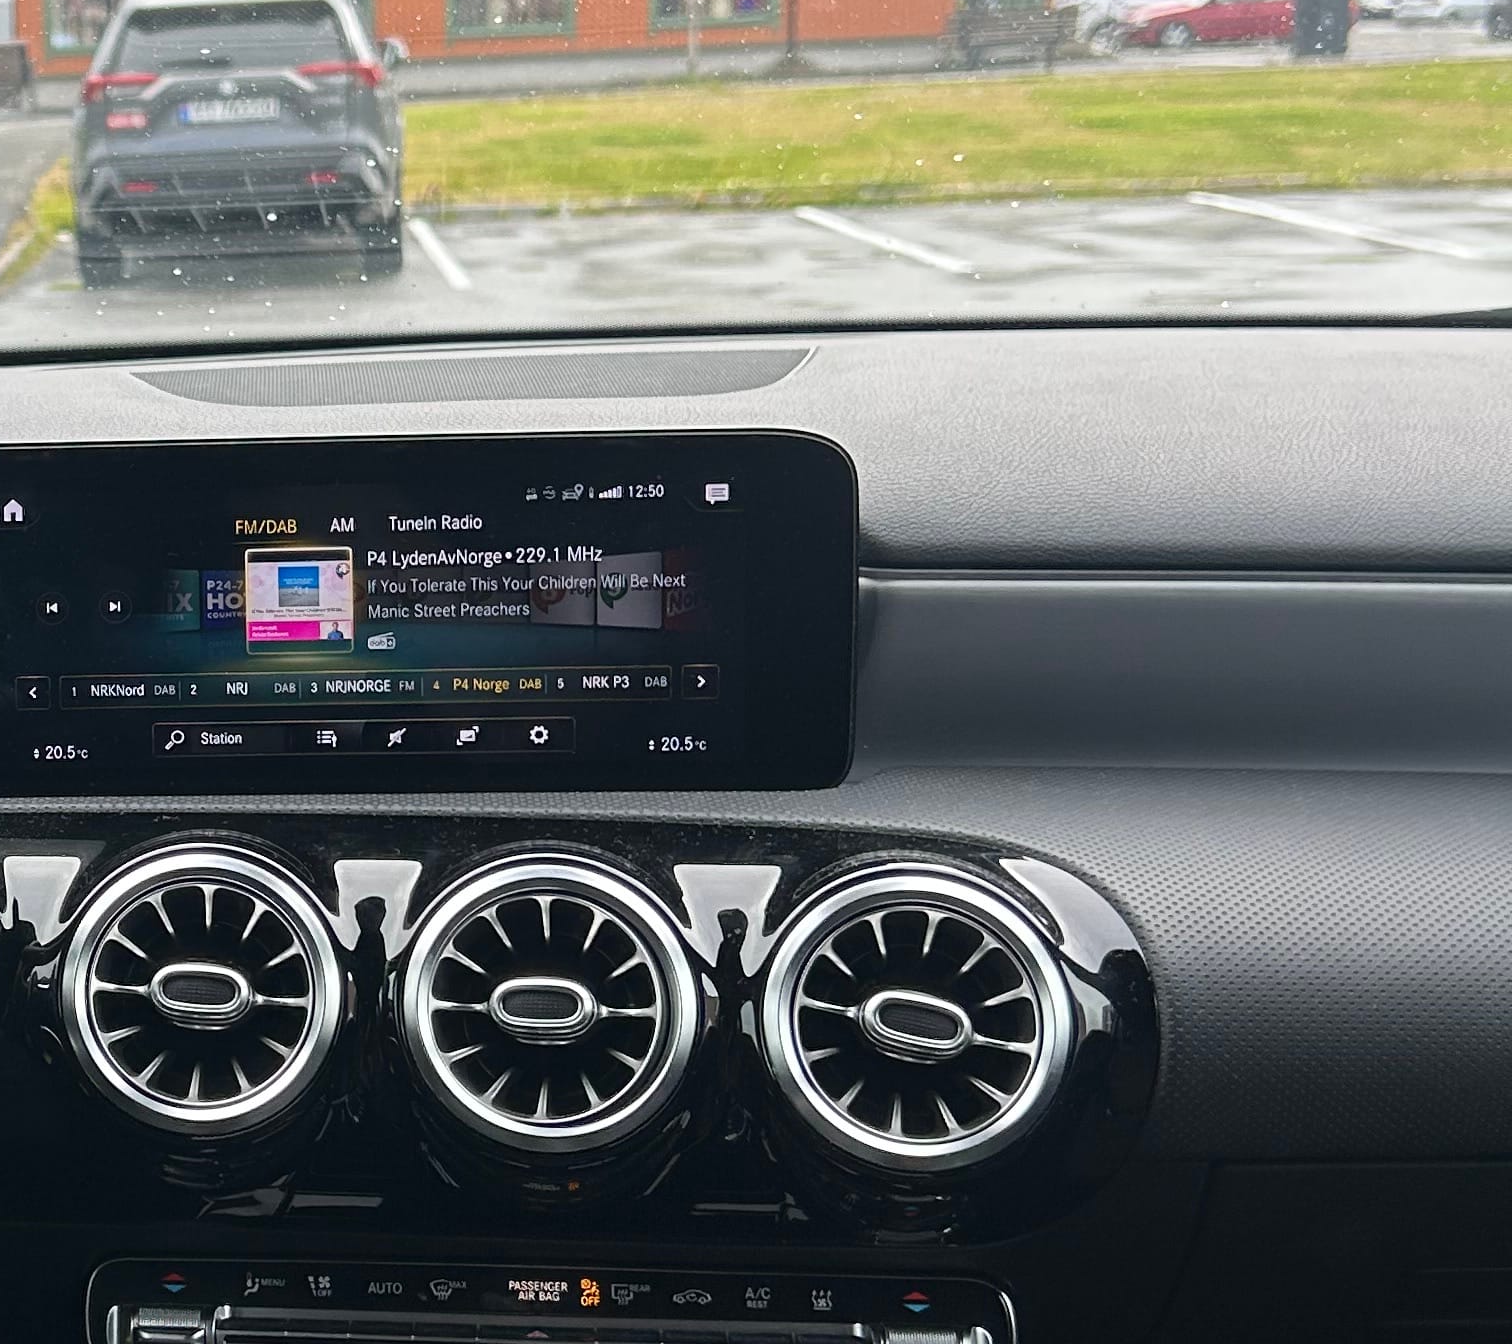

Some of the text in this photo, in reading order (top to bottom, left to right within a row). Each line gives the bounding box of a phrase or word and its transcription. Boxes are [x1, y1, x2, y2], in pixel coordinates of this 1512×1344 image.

[628, 483, 665, 498] 12:50
[235, 519, 298, 535] FM/DAB
[329, 517, 355, 532] AM
[388, 514, 483, 532] TuneIn Radio
[367, 546, 603, 569] P4 LydenAvNorge 229.1 MHz
[206, 580, 244, 591] P24-7
[367, 578, 378, 594] If
[380, 578, 407, 594] You
[410, 577, 467, 593] Tolerate
[470, 576, 498, 592] This
[501, 577, 534, 591] Your
[538, 575, 596, 590] Children
[600, 574, 626, 588] Will
[630, 574, 648, 588] Be
[652, 573, 686, 588] Next
[207, 592, 246, 610] HO
[367, 602, 530, 619] Manic Street Preachers
[190, 681, 297, 696] 2 NRJ DAB
[310, 679, 415, 693] 3 NRJNORGE FM
[433, 678, 542, 693] 4 P4 Norge DAB
[557, 675, 668, 690] 5 NRK P3 DAB
[71, 684, 176, 697] 1 NRKNord DAB
[200, 731, 243, 745] Station
[661, 737, 707, 752] 20.5°C
[45, 745, 89, 760] 20.5°C
[260, 1279, 286, 1287] MENU
[367, 1281, 403, 1295] AUTO
[448, 1281, 467, 1289] MAX
[508, 1280, 568, 1293] PASSENGER
[629, 1284, 651, 1293] REAR
[317, 1288, 332, 1297] OFF
[517, 1291, 561, 1302] AIR BAG
[744, 1287, 771, 1301] A/C
[580, 1297, 601, 1307] OFF
